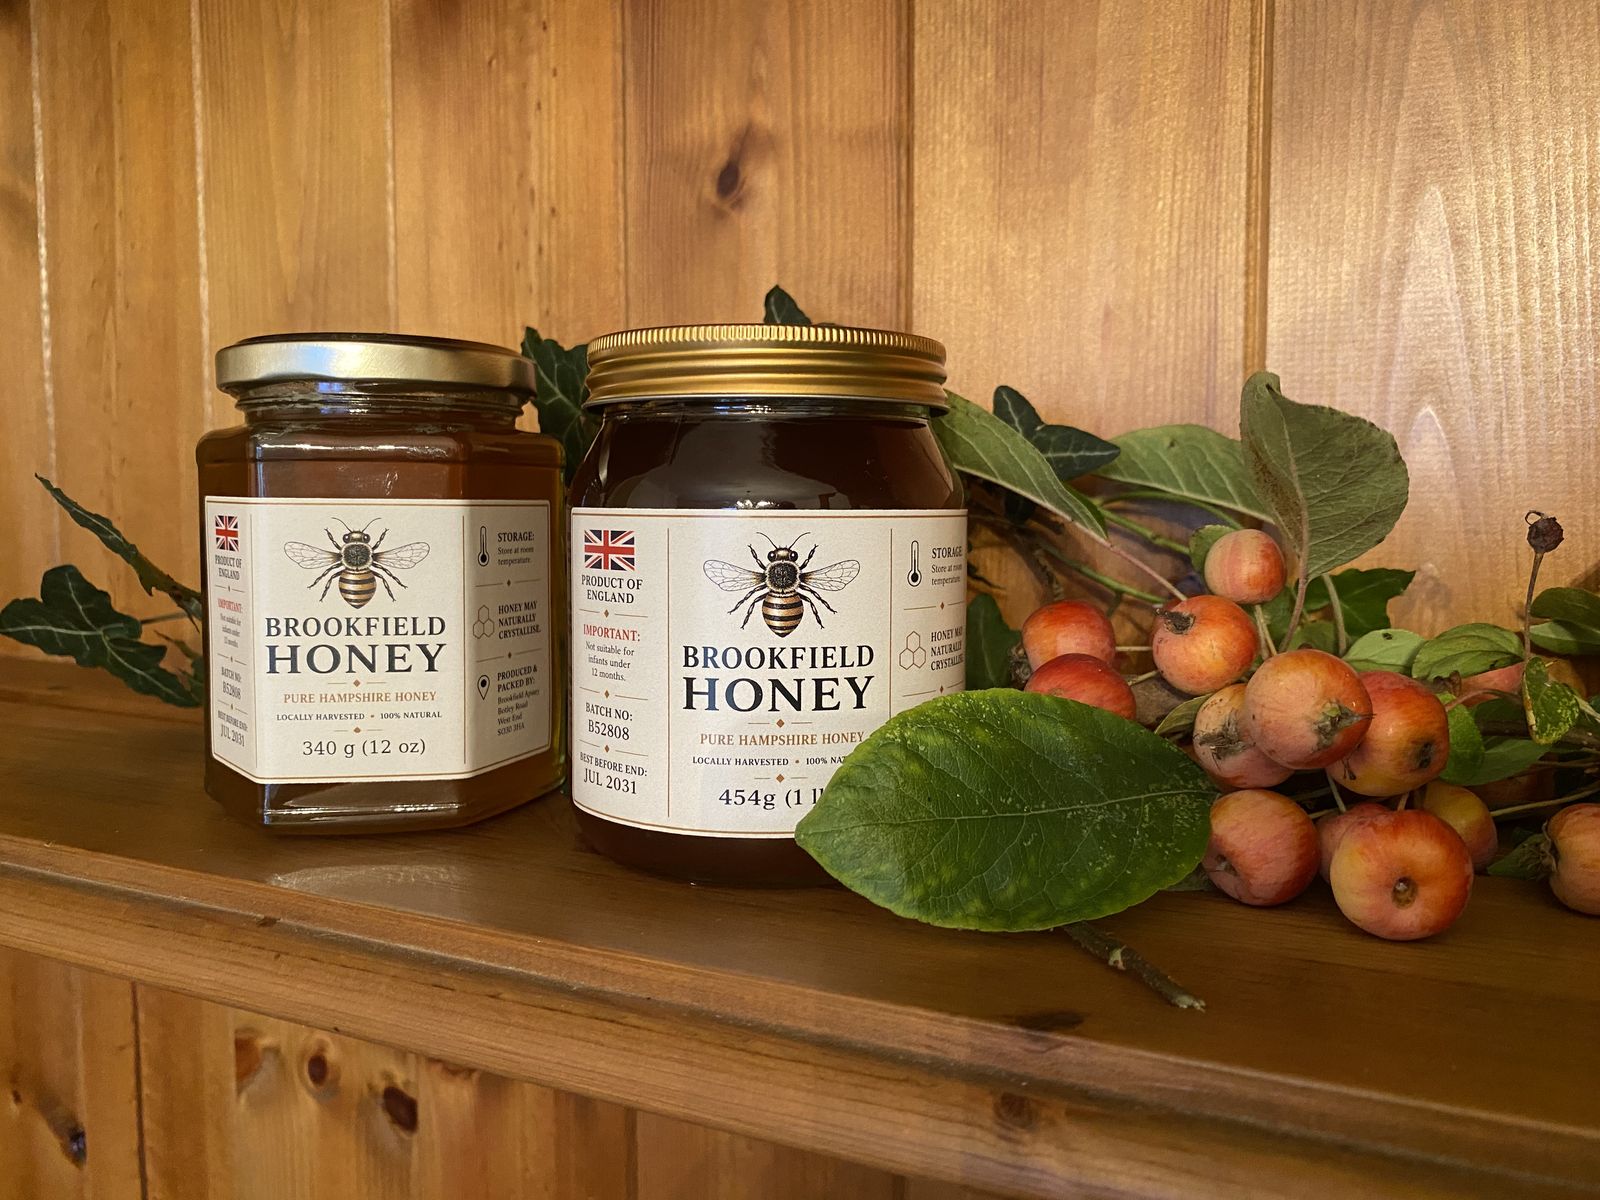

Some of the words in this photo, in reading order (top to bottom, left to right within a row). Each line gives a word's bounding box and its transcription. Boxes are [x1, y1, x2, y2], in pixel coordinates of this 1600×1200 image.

[497, 547, 512, 556] Store
[931, 564, 947, 574] Store
[581, 574, 625, 589] PRODUCT
[626, 578, 644, 590] OF
[587, 589, 635, 604] ENGLAND
[498, 603, 522, 615] HONEY
[523, 600, 538, 612] MAY
[264, 616, 447, 638] BROOKFIELD
[498, 613, 536, 628] NATURALLY
[583, 623, 641, 642] IMPORTANT:
[931, 629, 954, 642] HONEY
[585, 640, 595, 651] Not
[596, 643, 622, 655] suitable
[623, 646, 635, 656] for
[930, 640, 963, 657] NATURALLY
[265, 643, 448, 675] HONEY
[588, 654, 609, 666] infants
[609, 658, 631, 669] under
[682, 645, 875, 670] BROOKFIELD
[498, 666, 532, 681] PRODUCED
[532, 664, 538, 673] &
[591, 667, 599, 677] 12
[598, 669, 626, 682] months.
[498, 679, 524, 692] PACKED
[283, 693, 316, 704] PURE
[318, 692, 392, 703] HAMPSHIRE
[395, 690, 437, 702] HONEY
[682, 675, 875, 713] HONEY
[276, 713, 314, 721] LOCALLY
[315, 712, 365, 721] HARVESTED
[379, 712, 401, 720] 100%
[403, 711, 443, 719] NATURAL
[585, 702, 612, 718] BATCH
[614, 708, 633, 722] NO:
[588, 719, 630, 741] B52808
[700, 733, 735, 745] PURE
[738, 733, 818, 746] HAMPSHIRE
[822, 731, 865, 745] HONEY
[302, 740, 337, 756] 340
[343, 744, 355, 759] g
[361, 739, 392, 757] (12
[398, 738, 427, 756] oz)
[580, 751, 594, 765] BEST
[594, 756, 624, 773] BEFORE
[625, 764, 648, 777] END:
[692, 756, 732, 766] LOCALLY
[734, 757, 789, 766] HARVESTED
[806, 757, 828, 765] 100%
[583, 768, 603, 787] JUL
[605, 774, 637, 795] 2031
[718, 788, 776, 811] 454g
[784, 789, 802, 809] (1
